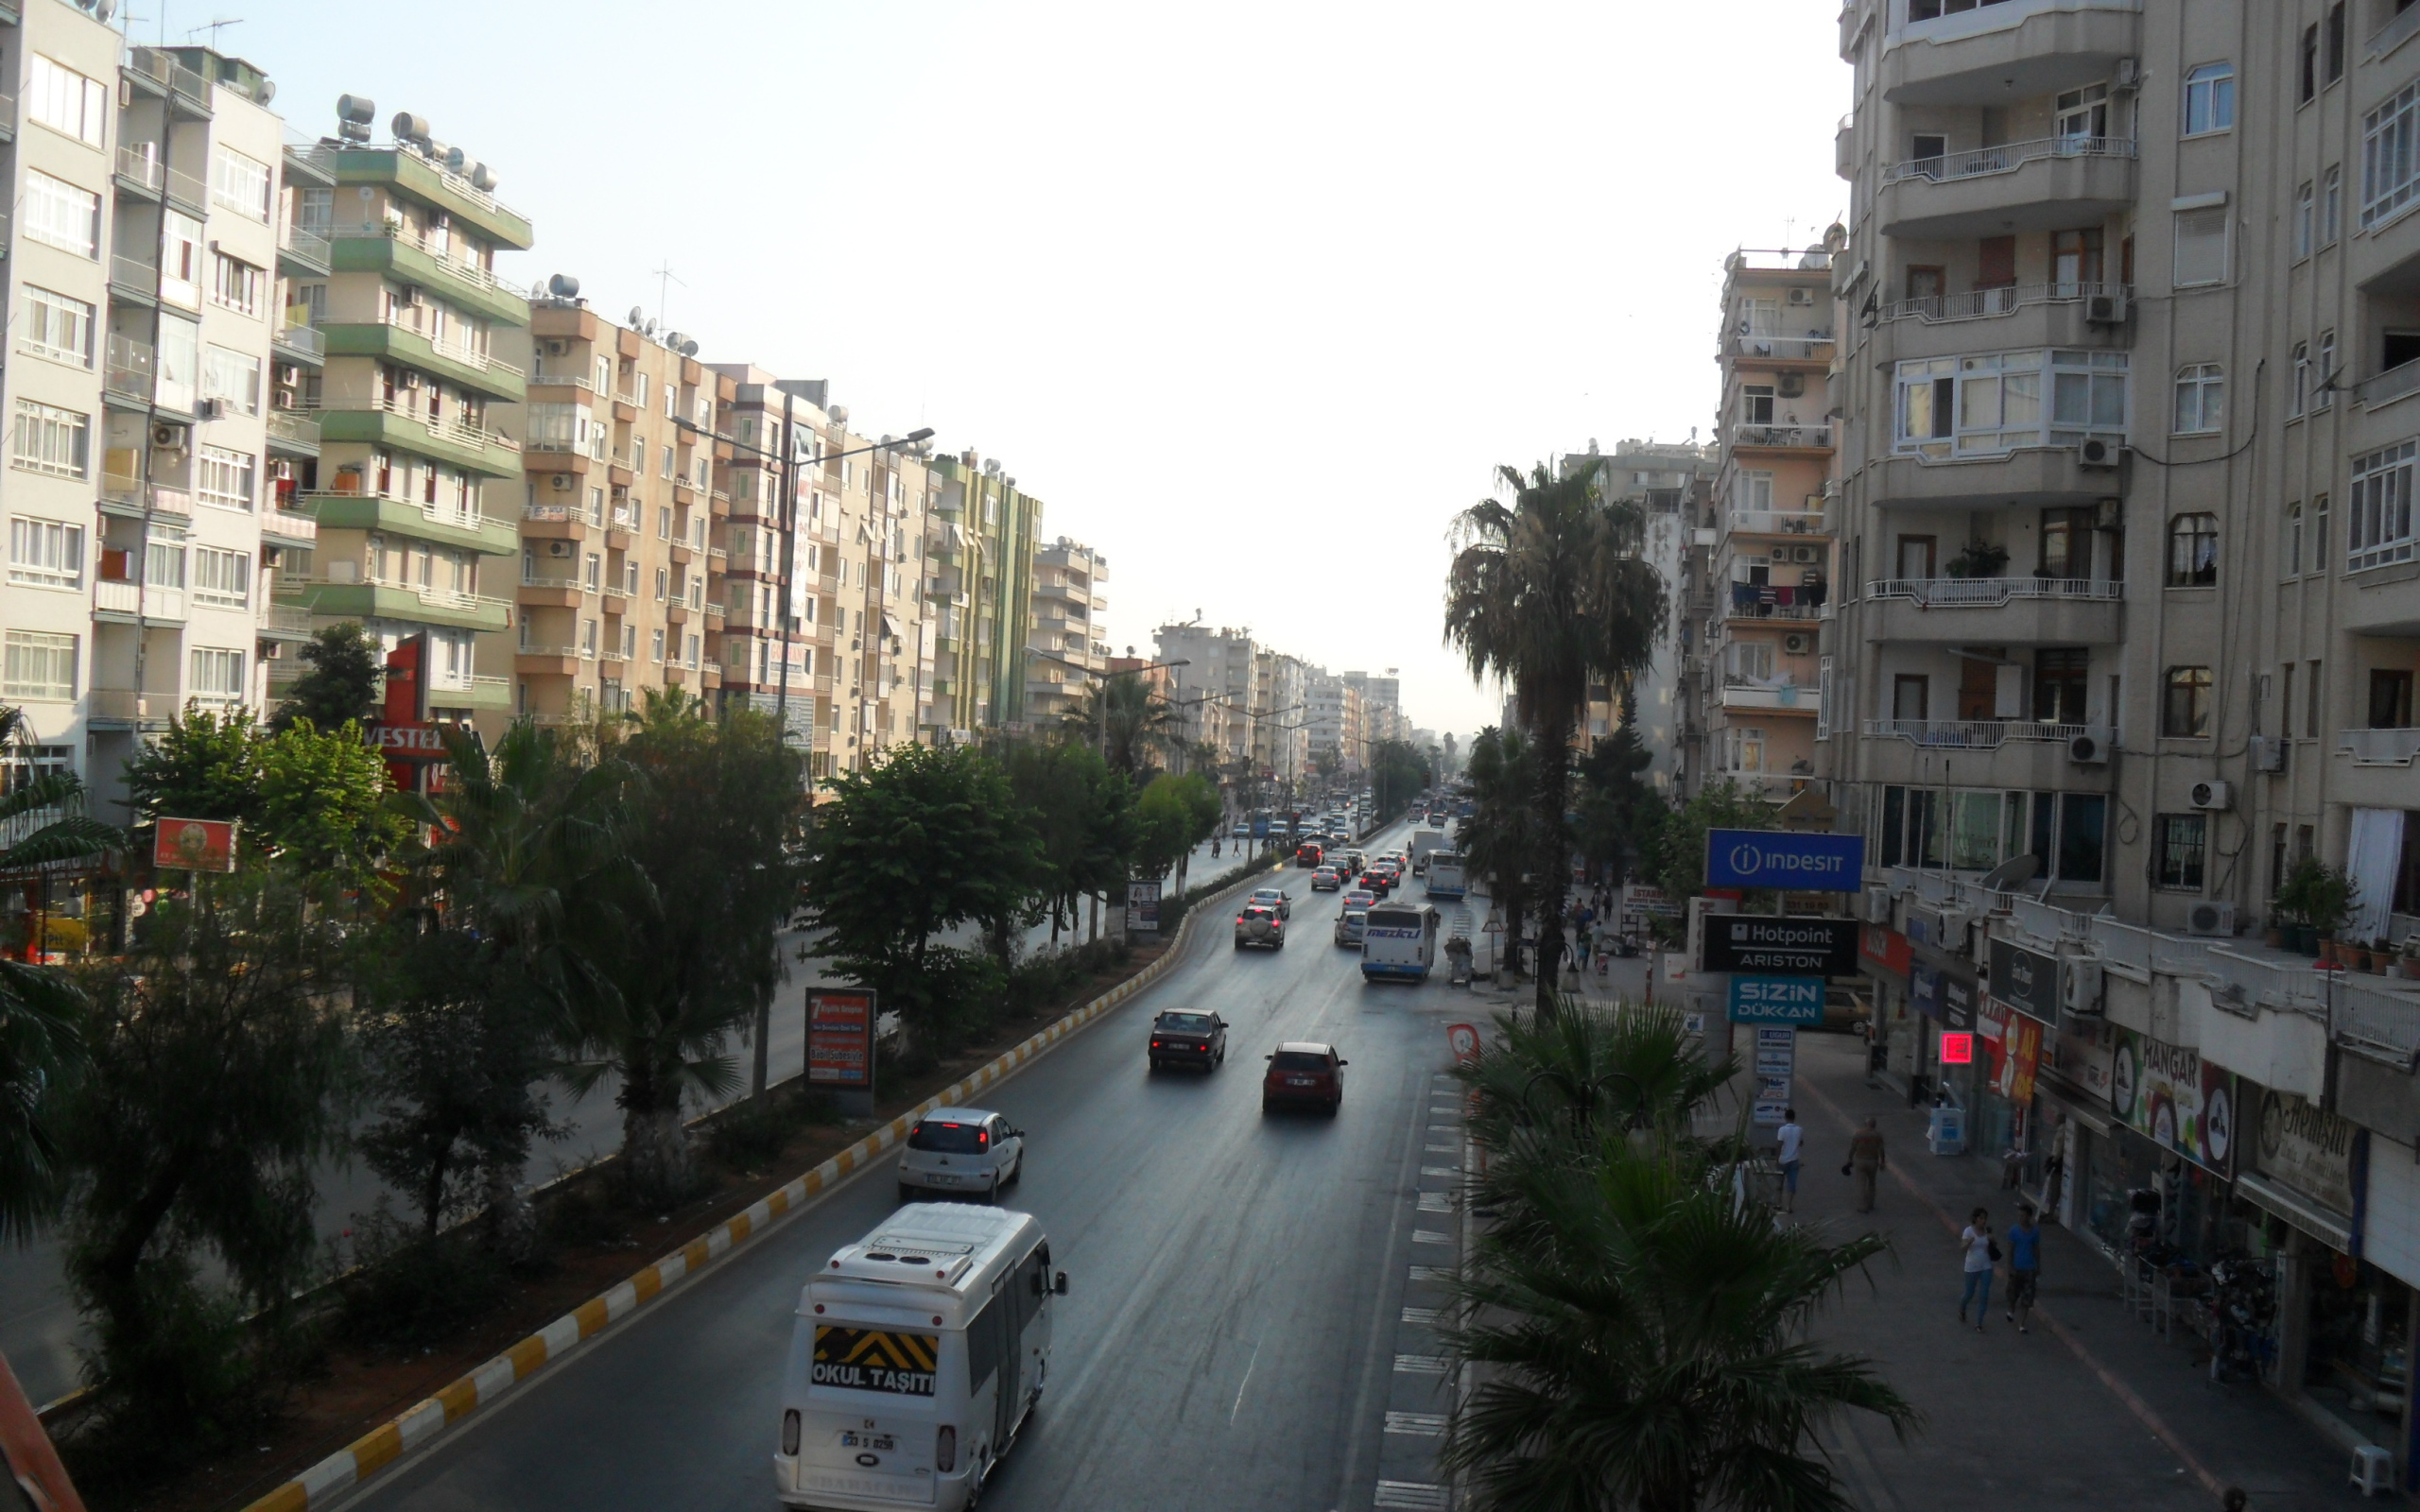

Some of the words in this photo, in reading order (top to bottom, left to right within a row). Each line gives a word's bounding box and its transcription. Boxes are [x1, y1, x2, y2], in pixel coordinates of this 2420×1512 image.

[1753, 925, 1832, 945] Hotpoint
[1740, 954, 1822, 968] ARISTON
[2143, 1036, 2197, 1090] HANGAR
[813, 1364, 866, 1385] OKUL
[870, 1369, 935, 1394] TAŞITI
